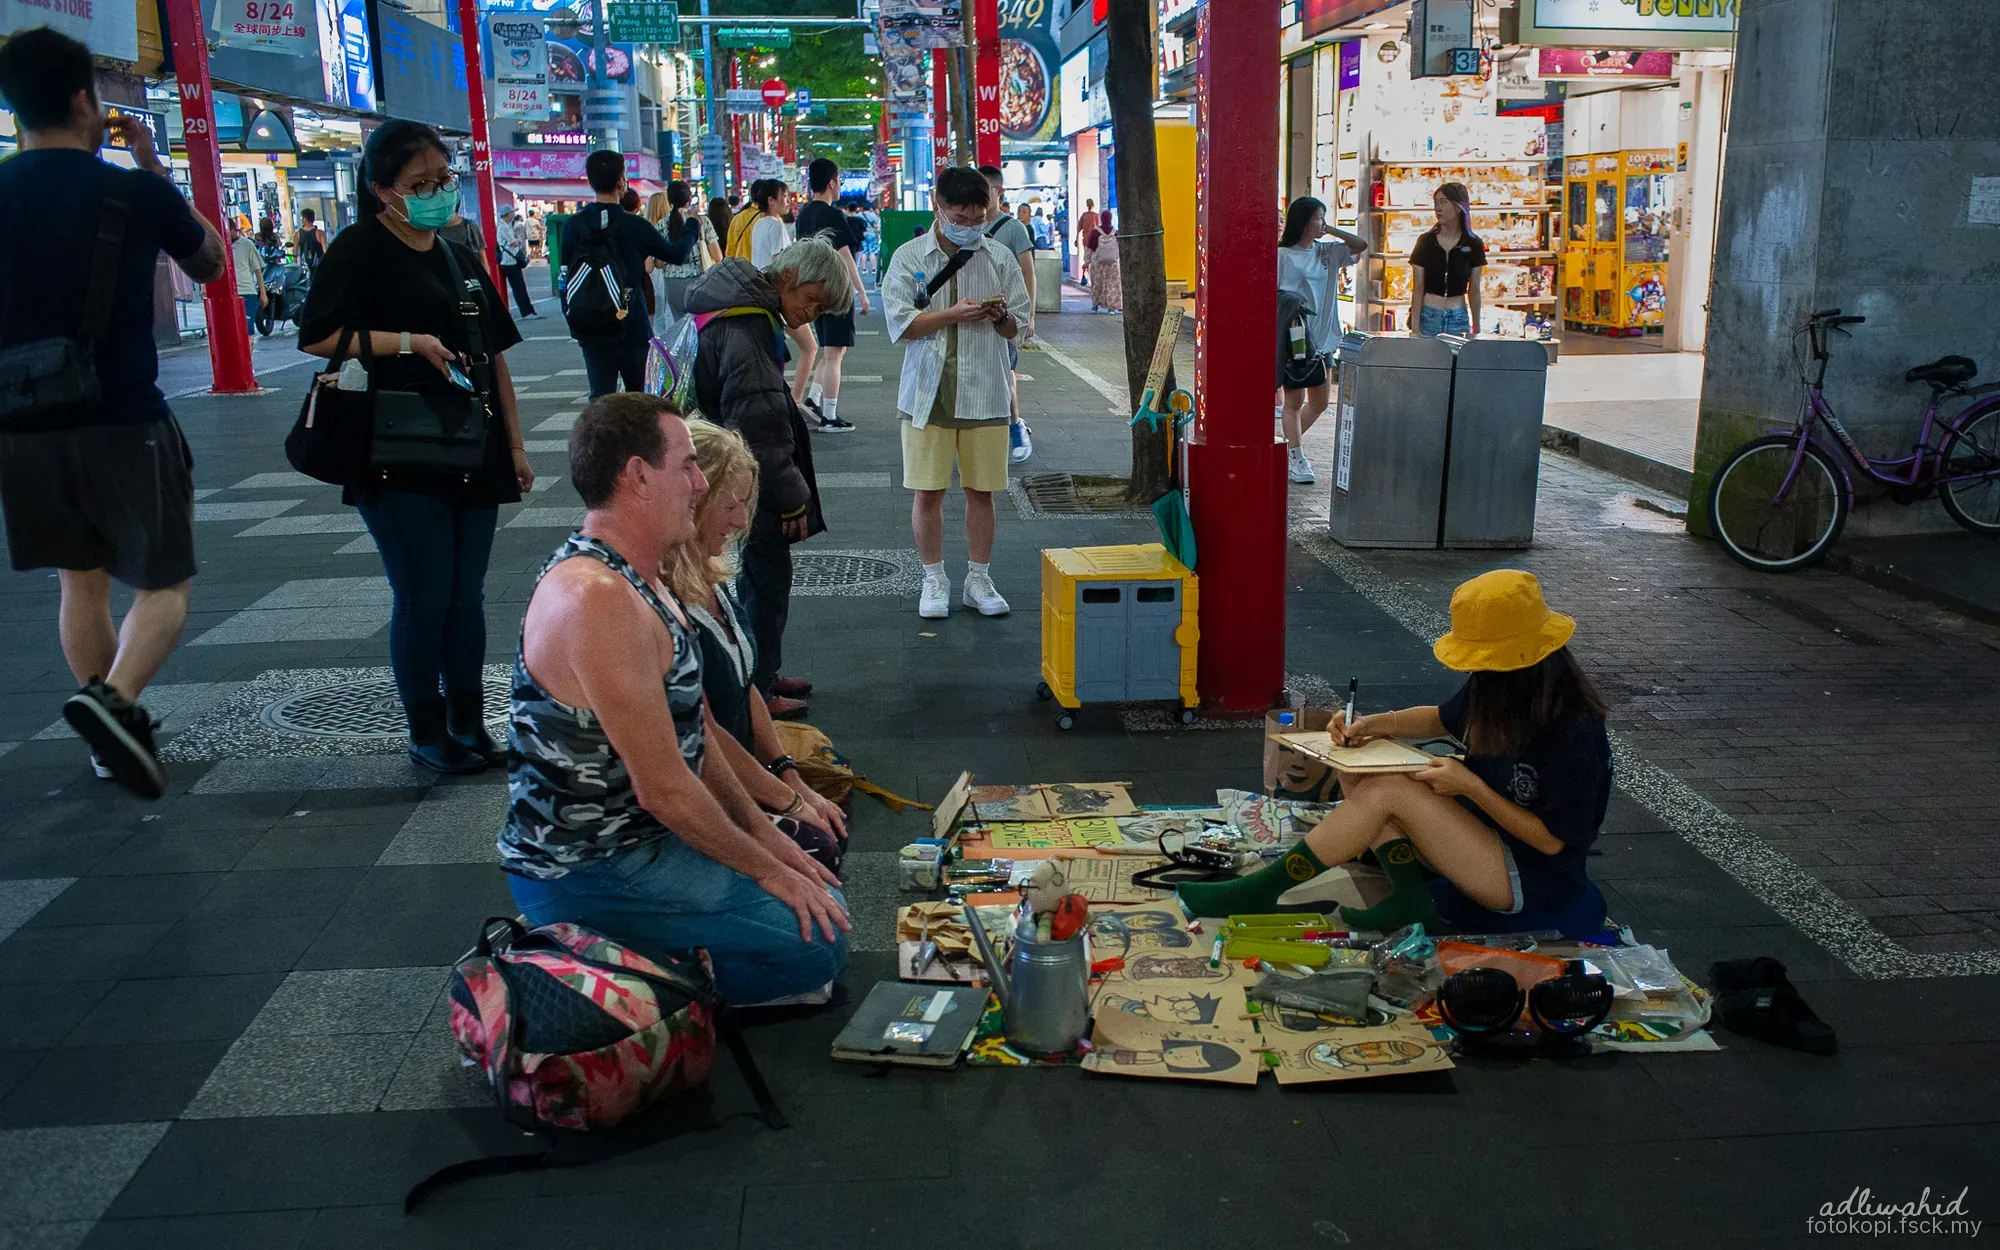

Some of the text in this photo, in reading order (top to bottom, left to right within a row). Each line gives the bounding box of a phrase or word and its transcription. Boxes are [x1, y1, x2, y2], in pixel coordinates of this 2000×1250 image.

[246, 1, 294, 22] 8/24
[613, 5, 670, 17] 西寧南路
[233, 22, 307, 38] 全球同步上線
[181, 83, 201, 100] W
[508, 89, 538, 101] 8/24
[978, 85, 997, 101] W
[184, 118, 208, 134] 29
[979, 118, 999, 133] 30
[475, 141, 486, 151] W
[935, 137, 947, 148] W
[476, 160, 489, 171] 27
